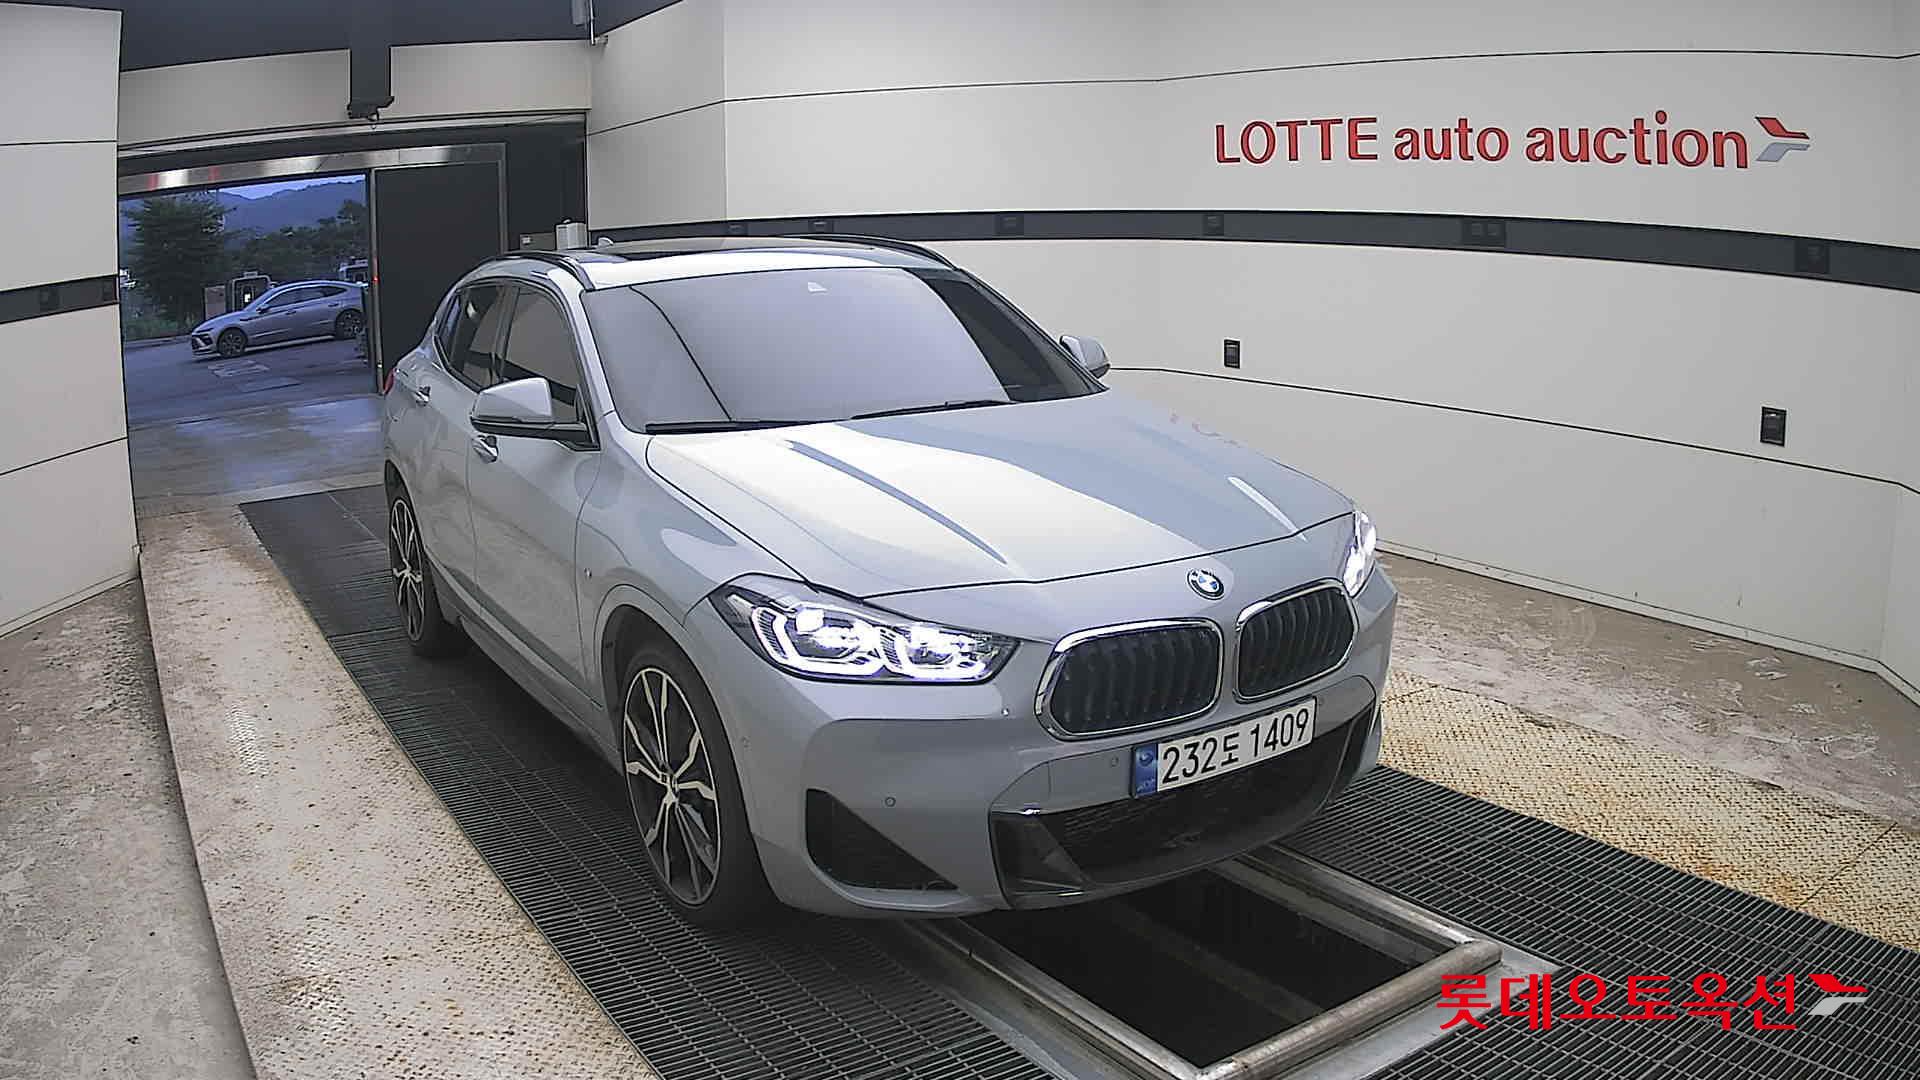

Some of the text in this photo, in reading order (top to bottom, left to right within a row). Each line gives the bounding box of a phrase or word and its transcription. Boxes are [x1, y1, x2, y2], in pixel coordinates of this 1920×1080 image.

[1215, 110, 1750, 169] LOTTE auto auction
[1161, 707, 1310, 784] 232도 1409
